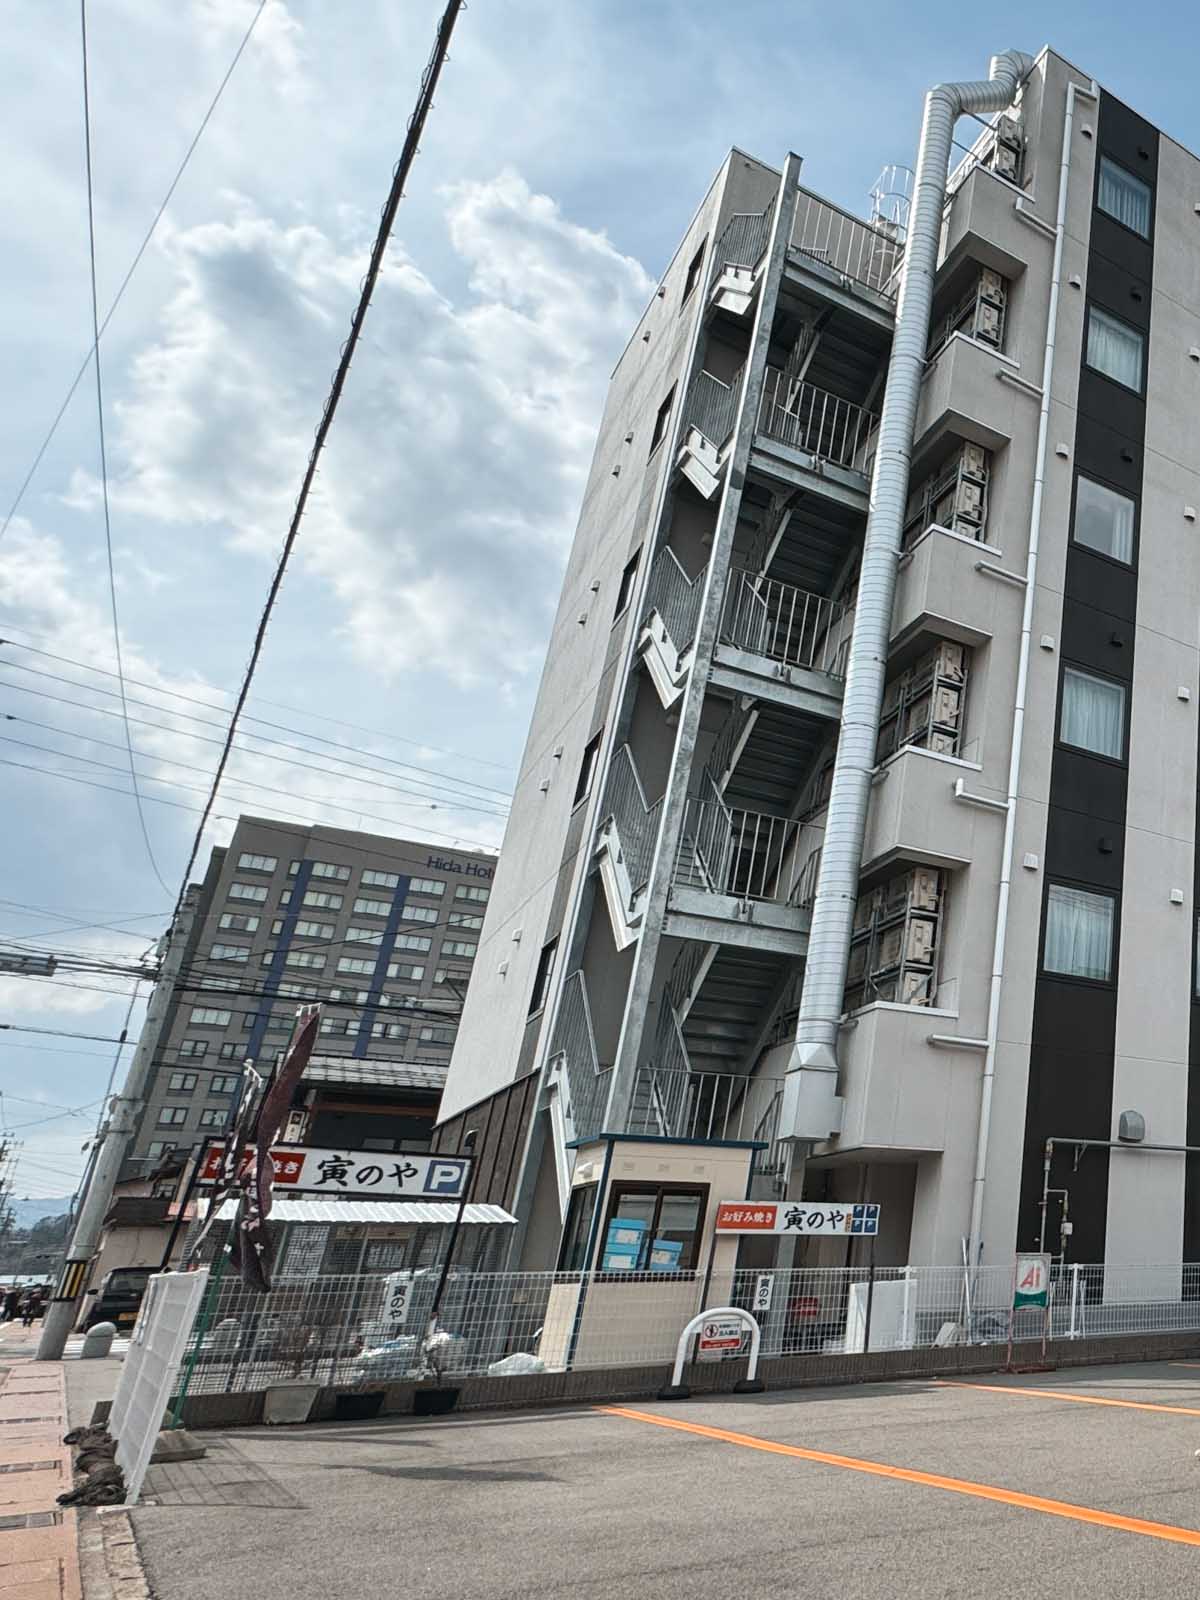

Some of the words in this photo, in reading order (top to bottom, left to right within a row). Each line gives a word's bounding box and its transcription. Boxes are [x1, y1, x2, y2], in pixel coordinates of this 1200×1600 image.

[427, 856, 463, 874] Hida
[464, 862, 495, 880] Hot
[313, 1154, 419, 1188] 寅のや
[430, 1163, 461, 1191] P
[721, 1211, 773, 1224] お好み焼き
[783, 1205, 845, 1231] 寅のや
